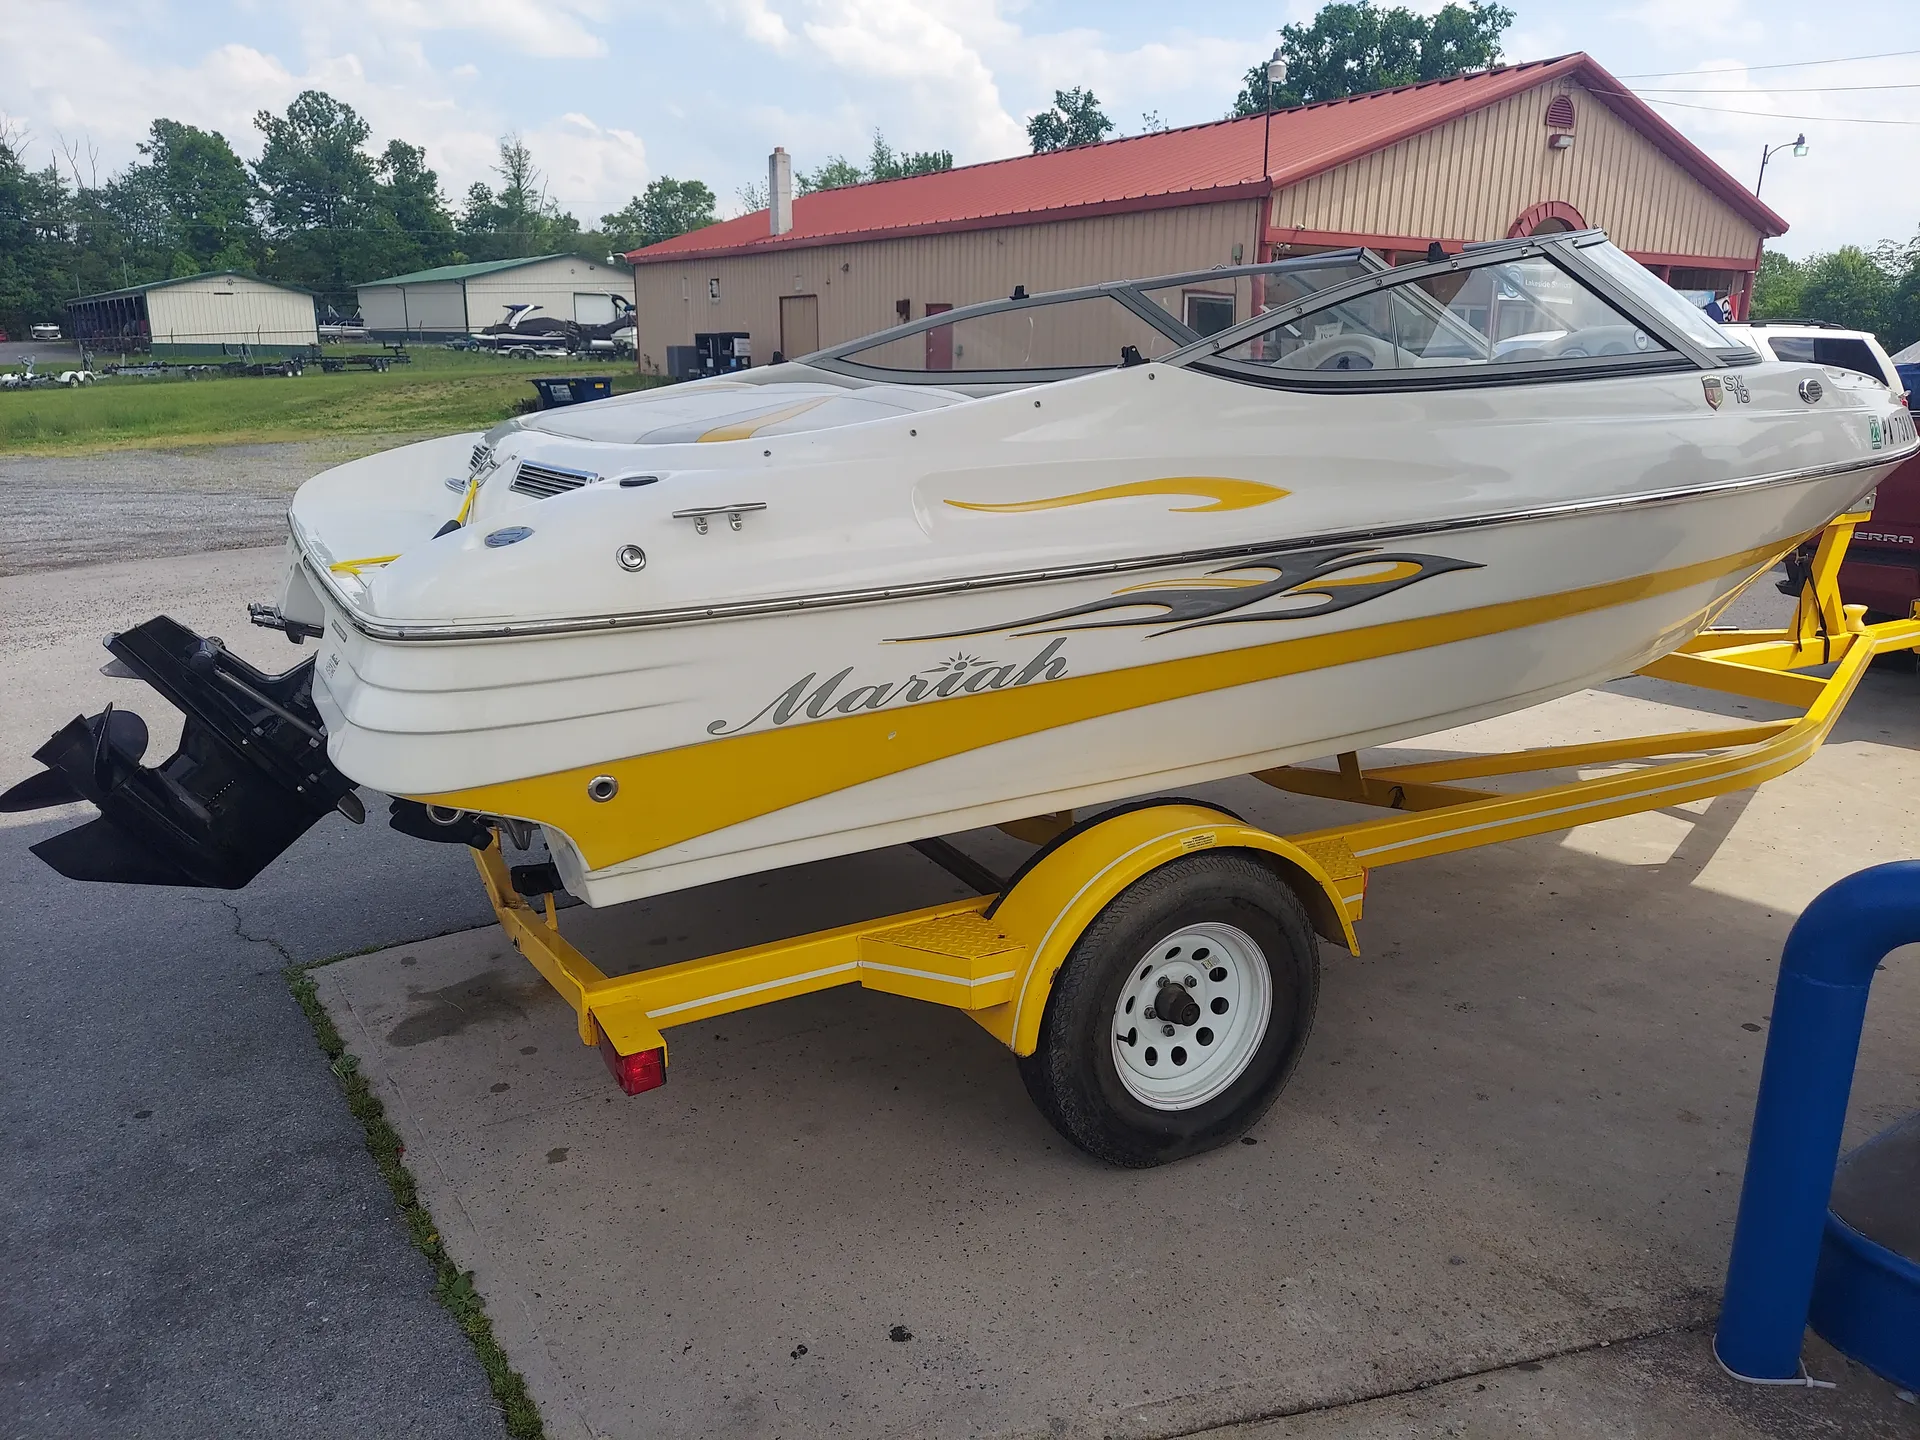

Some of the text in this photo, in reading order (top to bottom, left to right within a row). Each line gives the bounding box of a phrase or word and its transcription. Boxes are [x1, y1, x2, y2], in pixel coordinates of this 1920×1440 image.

[1723, 375, 1744, 391] SX
[1734, 388, 1751, 403] 18
[1882, 418, 1894, 445] PA
[1852, 531, 1914, 544] ERRA
[707, 637, 1069, 736] Mariah
